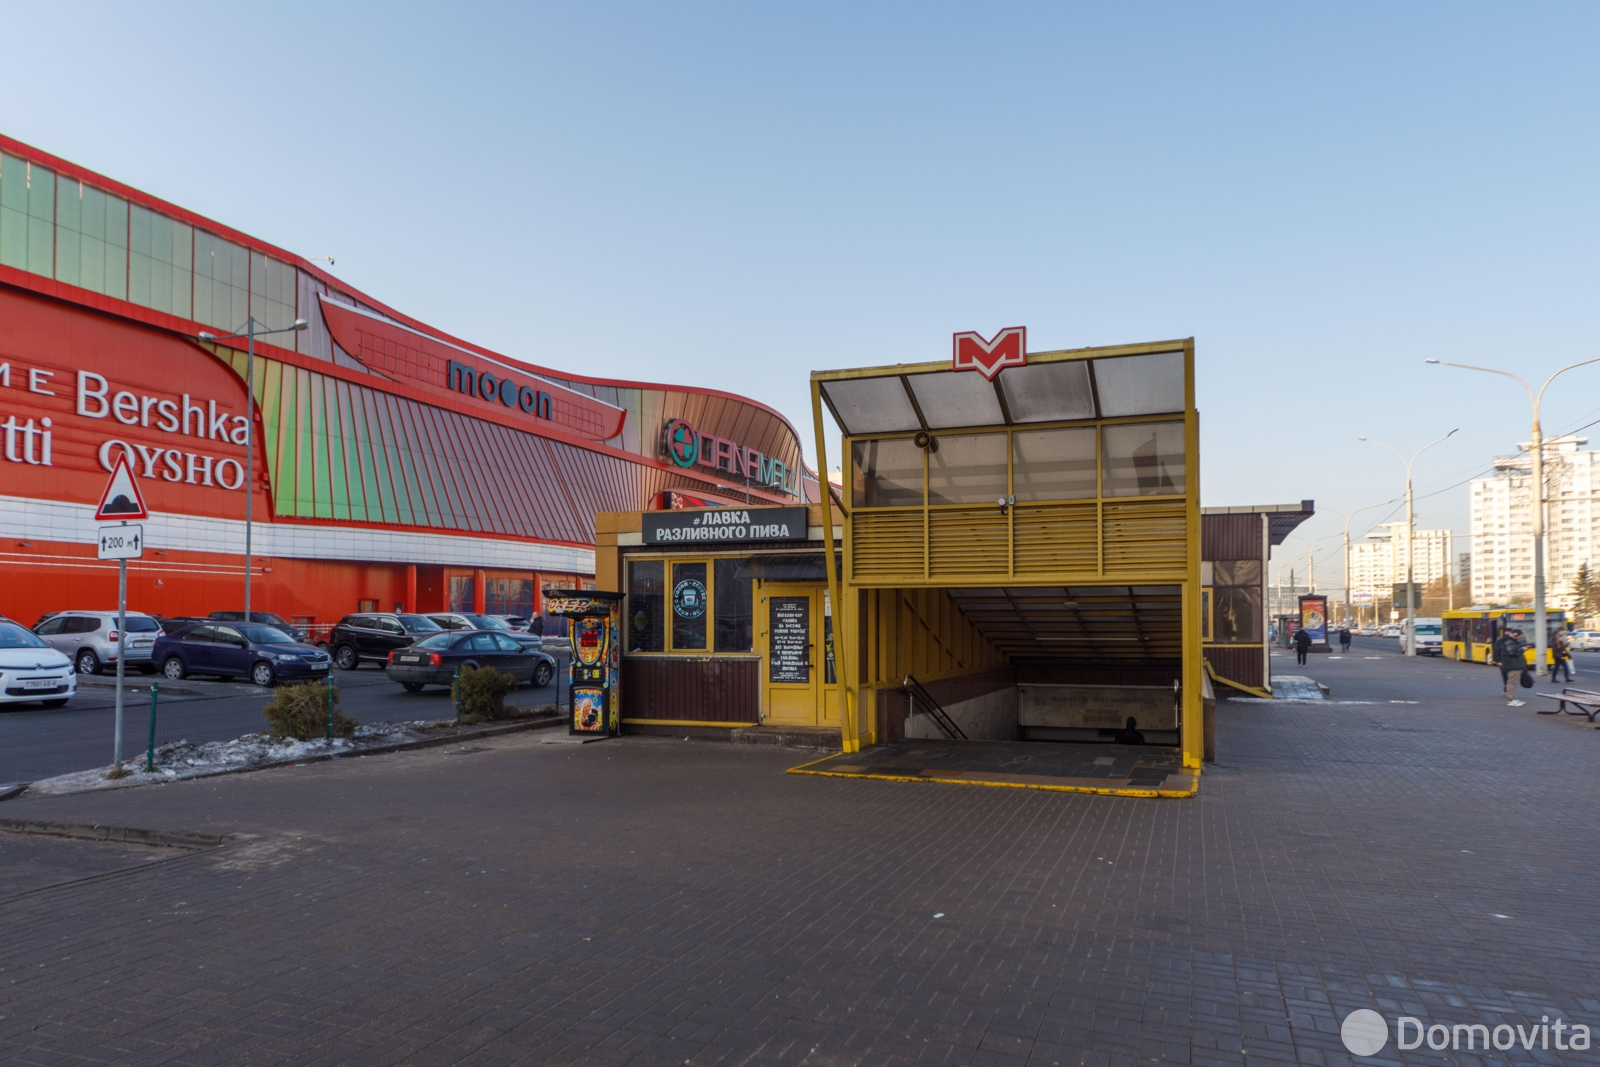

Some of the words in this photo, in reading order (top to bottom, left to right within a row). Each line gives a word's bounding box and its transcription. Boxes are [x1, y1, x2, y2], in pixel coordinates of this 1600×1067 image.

[77, 370, 250, 446] Bershka
[99, 439, 245, 490] OYSHO
[108, 537, 124, 548] 200
[656, 525, 746, 541] РАЗЛИВНОГО
[750, 524, 790, 538] ПИВА
